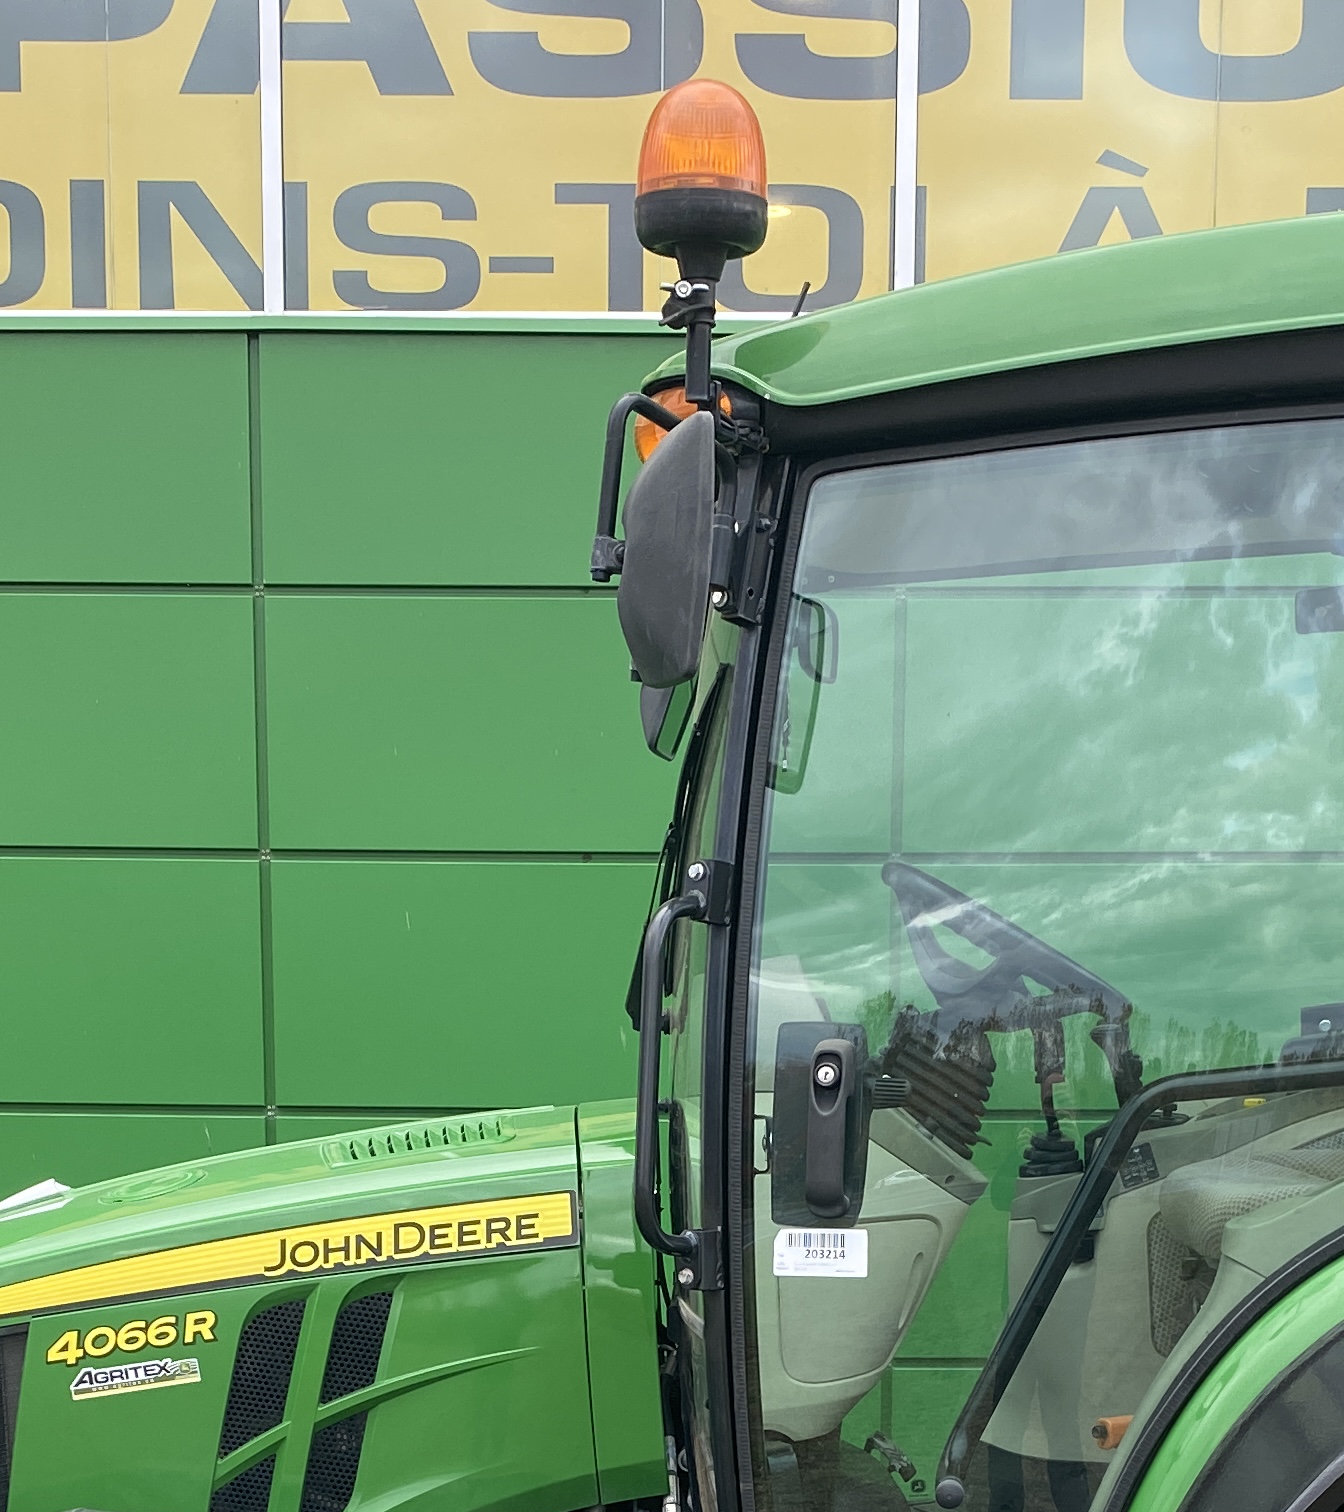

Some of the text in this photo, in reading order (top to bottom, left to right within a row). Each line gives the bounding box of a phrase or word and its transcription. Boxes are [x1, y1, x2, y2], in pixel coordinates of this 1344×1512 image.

[263, 1211, 542, 1274] JOHN DEERE
[804, 1249, 846, 1260] 203214
[74, 1361, 171, 1387] AGRITEX
